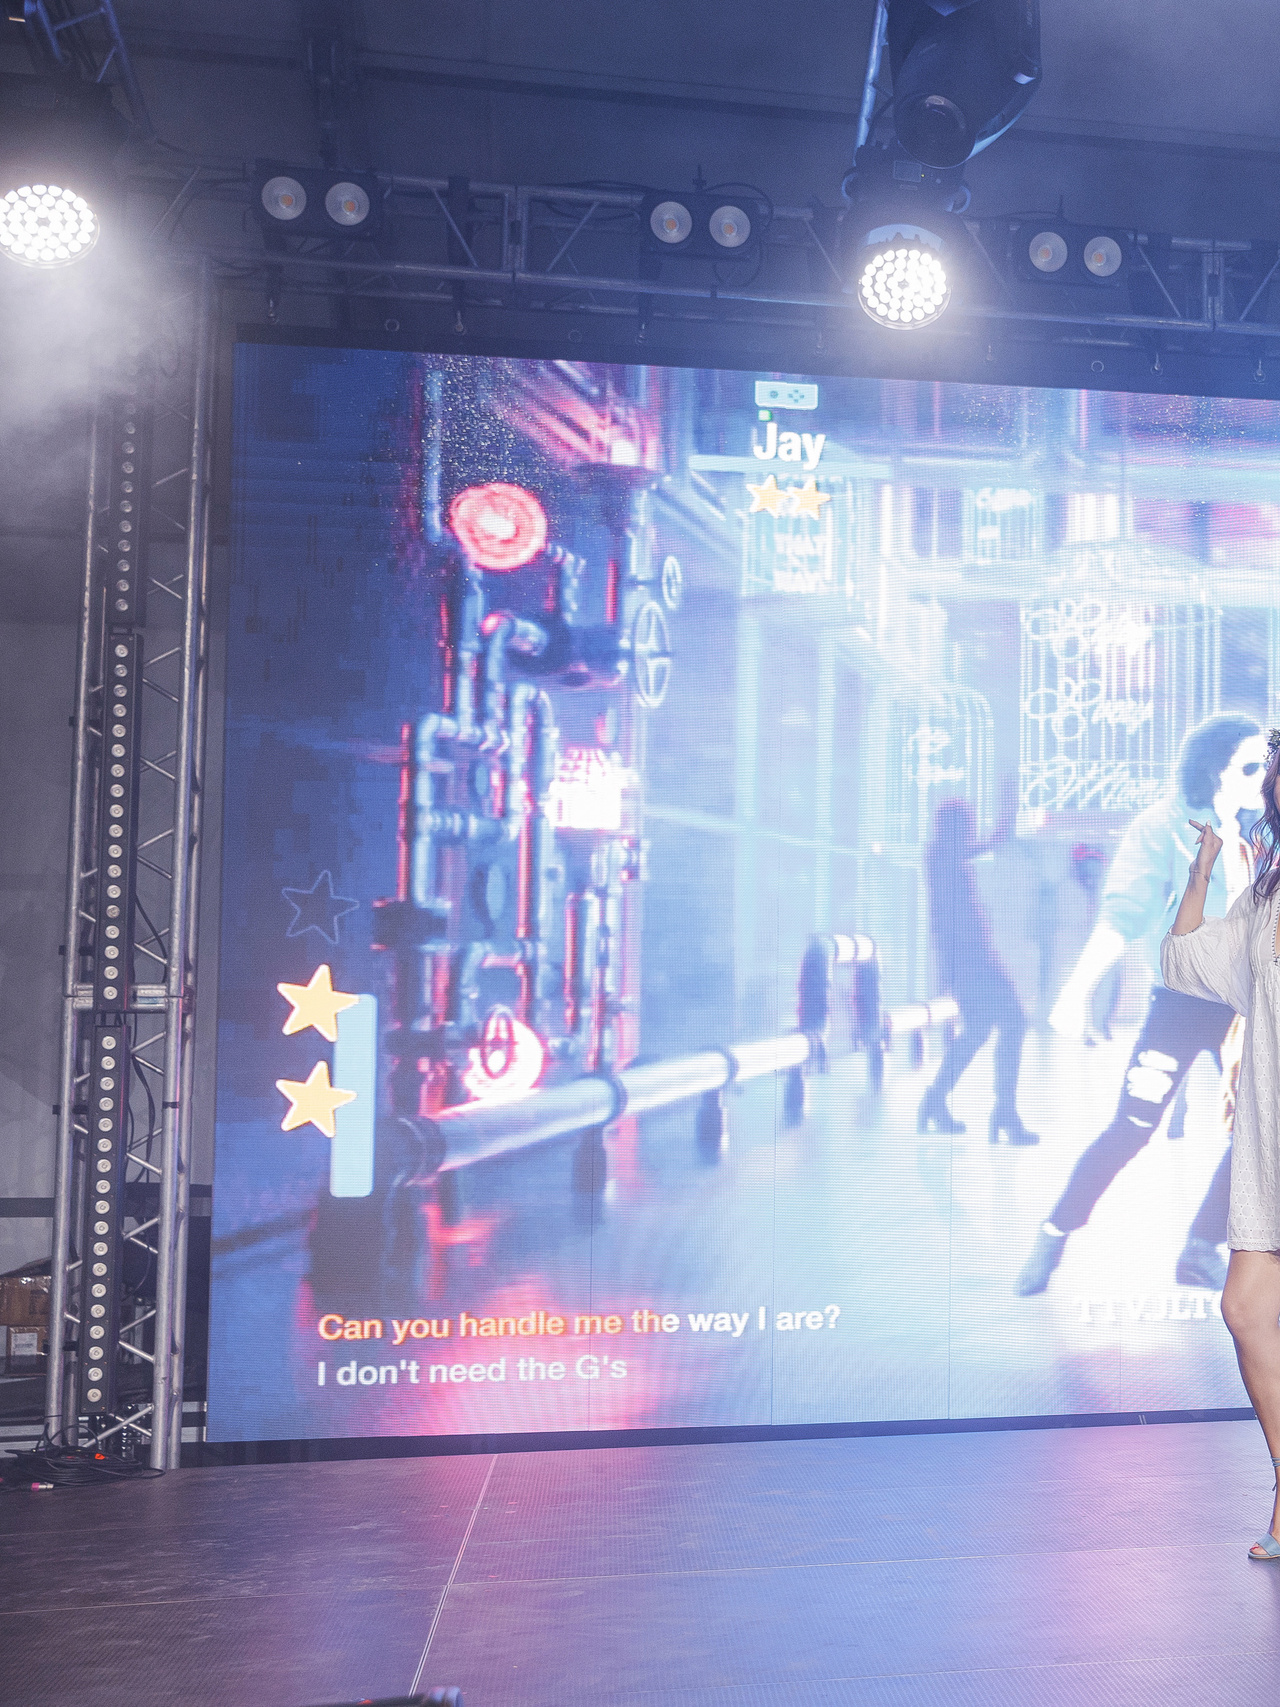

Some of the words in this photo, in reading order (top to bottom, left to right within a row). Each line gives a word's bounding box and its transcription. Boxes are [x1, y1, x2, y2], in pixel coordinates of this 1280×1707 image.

[753, 422, 827, 470] Jay
[317, 1313, 383, 1340] Can
[391, 1318, 450, 1345] you
[459, 1311, 565, 1337] handle
[574, 1315, 623, 1335] me
[631, 1309, 680, 1333] the
[687, 1312, 750, 1338] way
[757, 1306, 767, 1331] I
[775, 1304, 842, 1331] are?
[316, 1361, 326, 1387] I
[336, 1359, 420, 1386] don't
[429, 1357, 507, 1383] need
[517, 1356, 567, 1382] the
[574, 1354, 629, 1380] G's
